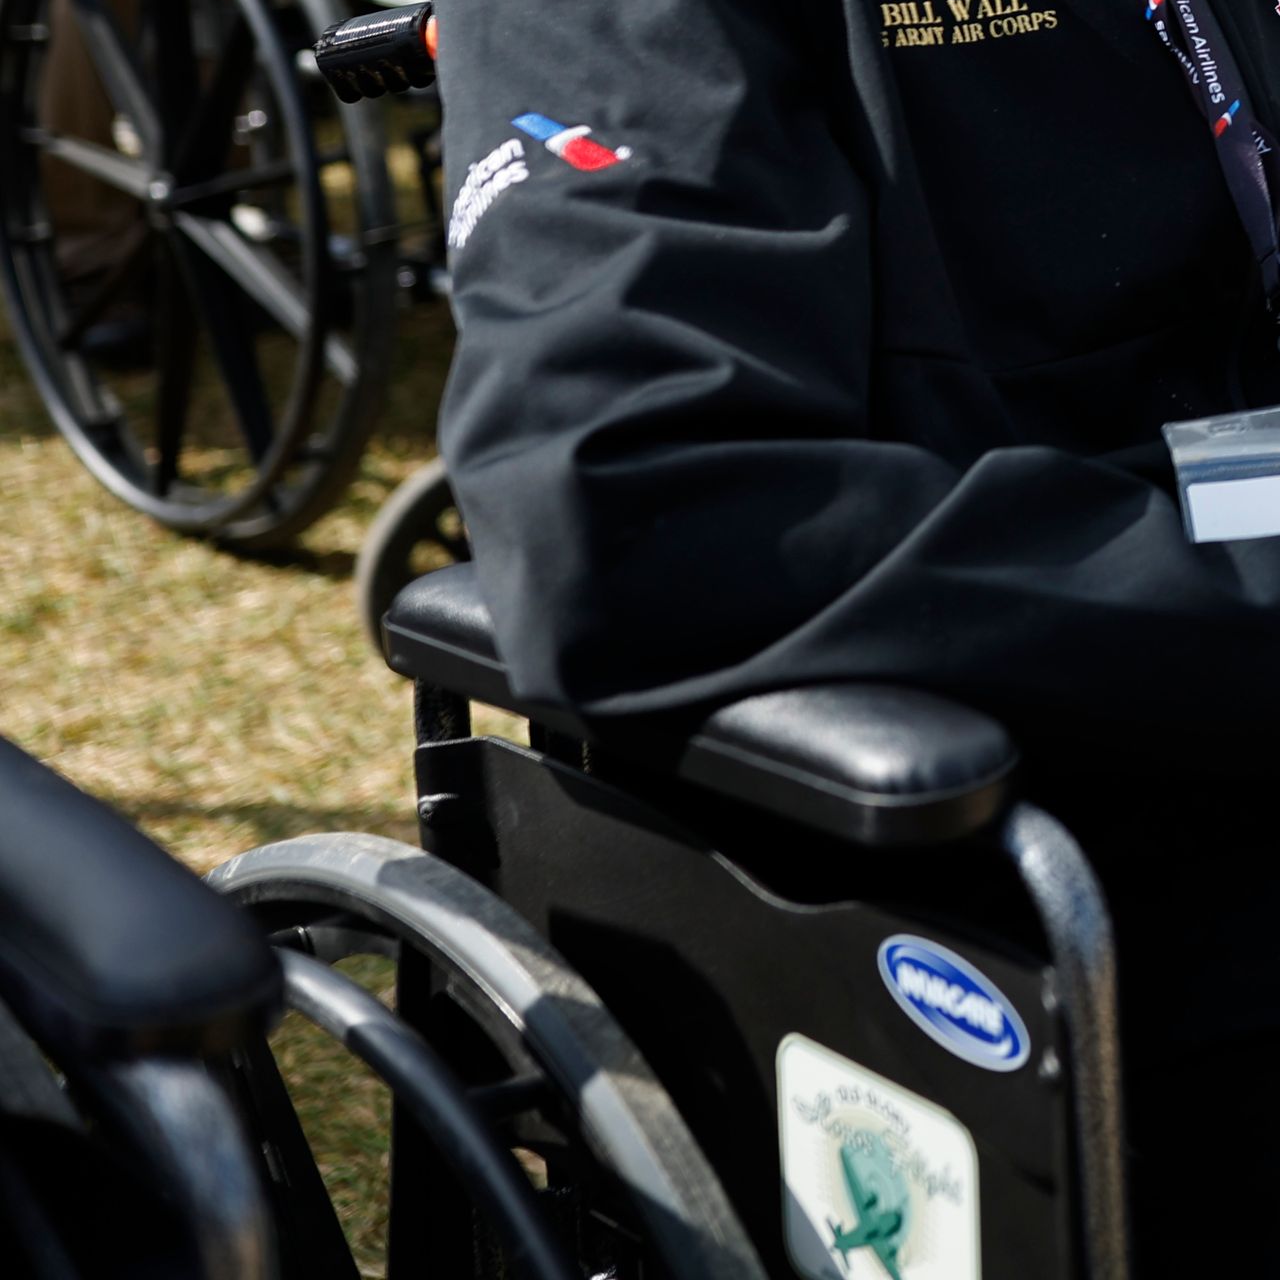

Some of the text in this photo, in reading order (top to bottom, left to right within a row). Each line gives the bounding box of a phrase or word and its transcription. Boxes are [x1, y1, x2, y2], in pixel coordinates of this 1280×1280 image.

[879, 0, 943, 27] BILL
[894, 26, 945, 48] ARMY
[951, 23, 986, 45] AIR
[988, 9, 1059, 39] CORPS
[1191, 35, 1226, 105] Airlines
